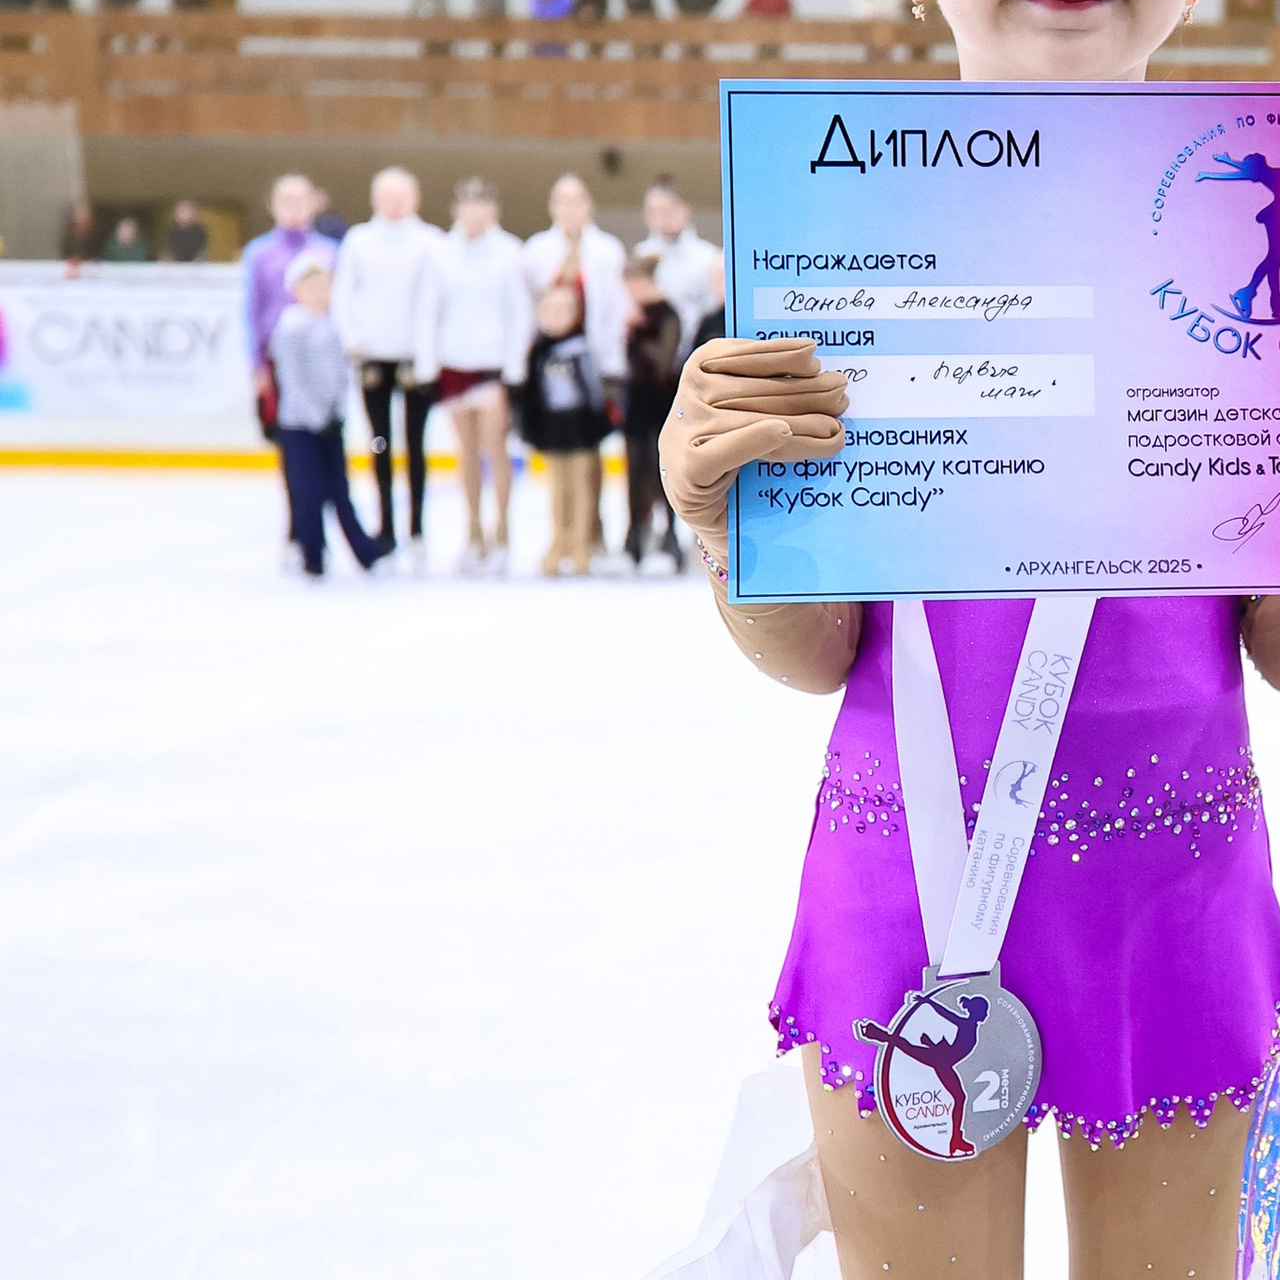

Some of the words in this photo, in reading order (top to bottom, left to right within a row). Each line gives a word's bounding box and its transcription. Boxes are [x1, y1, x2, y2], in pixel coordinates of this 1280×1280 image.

[1152, 123, 1226, 223] СОРЕВНОВАНИЯ
[1236, 114, 1256, 128] ПО
[753, 249, 936, 276] Награждается
[783, 290, 876, 312] Ханова
[894, 289, 1033, 322] Александра
[1150, 278, 1263, 361] КУБОК
[30, 311, 228, 366] CANDY
[1126, 386, 1220, 401] огранизатор
[1127, 406, 1208, 422] магазин
[1128, 430, 1271, 452] подростковой
[758, 461, 787, 478] по
[793, 458, 935, 483] фигурному
[942, 459, 1045, 475] катанию
[1128, 457, 1202, 482] Candy
[1208, 457, 1251, 476] Kids
[1256, 462, 1266, 476] &
[1016, 559, 1143, 576] АРХАНГЕЛЬСК
[1147, 559, 1192, 574] 2025
[1011, 650, 1048, 731] CANDY
[1033, 653, 1073, 736] КУБОК
[993, 833, 1006, 851] по
[966, 829, 988, 889] катанию
[971, 853, 1002, 930] фигурному
[988, 836, 1026, 937] Соревнования
[894, 1089, 943, 1108] КУБОК
[972, 1070, 1001, 1113] 2
[904, 1102, 953, 1121] CANDY
